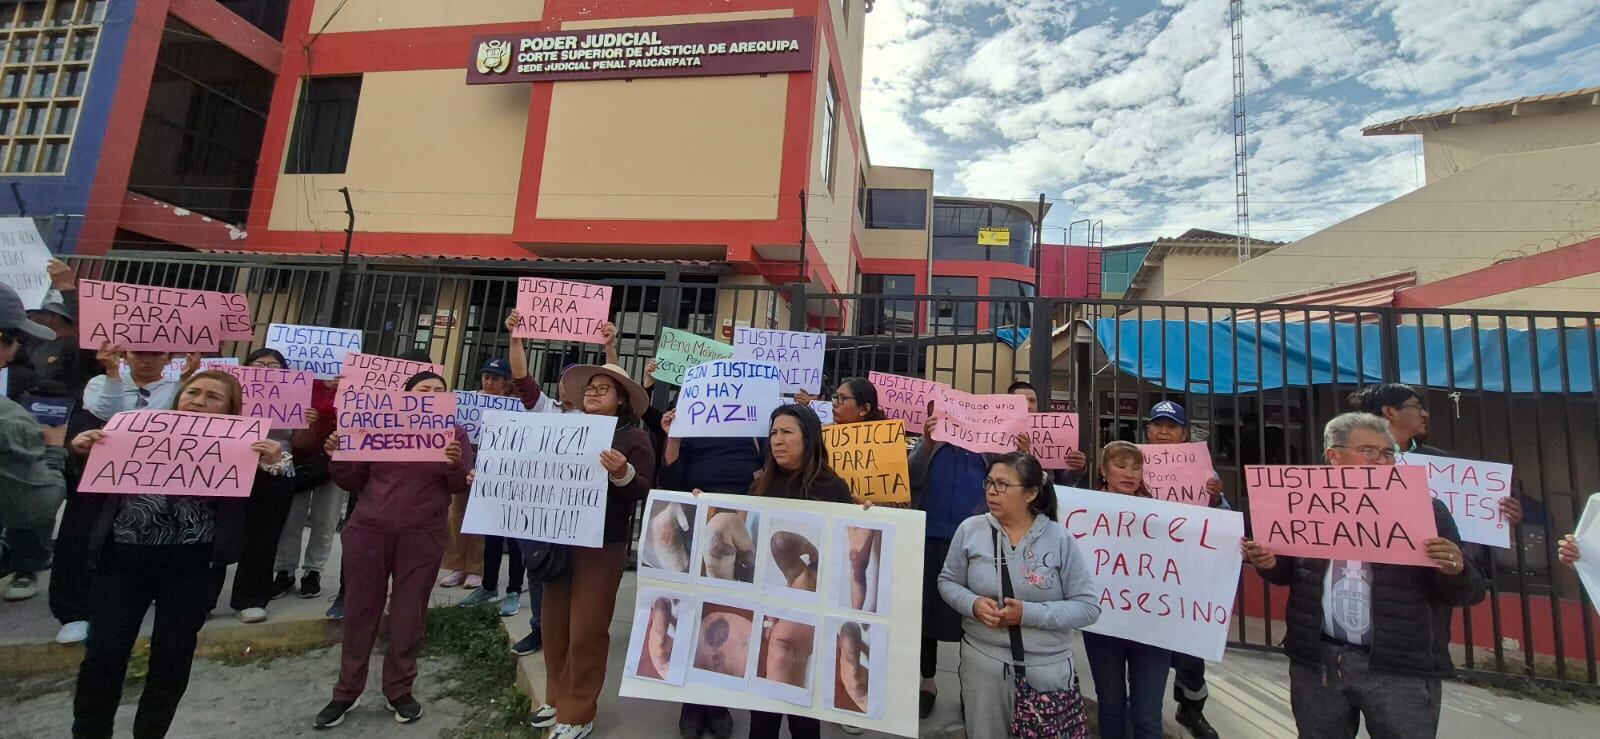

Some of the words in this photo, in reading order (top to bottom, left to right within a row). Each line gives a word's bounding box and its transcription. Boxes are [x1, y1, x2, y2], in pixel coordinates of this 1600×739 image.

[517, 51, 558, 63] CORTE
[560, 47, 624, 61] SUPERIOR
[626, 46, 643, 58] DE
[645, 43, 706, 57] JUSTICIA
[708, 42, 726, 54] DE
[728, 39, 799, 54] AREQUIPA
[520, 36, 578, 51] PODER
[580, 31, 662, 49] JUDICIAL
[517, 63, 543, 73] SEDE
[544, 61, 591, 72] JUDICIAL
[592, 59, 627, 70] PENAL
[628, 56, 701, 69] PAUCARPATA
[83, 281, 207, 311] JUSTICIA
[520, 279, 605, 301] JUSTICIA
[113, 304, 183, 325] PARA
[532, 296, 578, 313] PARA
[90, 322, 214, 346] ARIANA
[516, 315, 604, 335] ARIANITA
[271, 325, 361, 349] JUSTICIA
[736, 328, 823, 351] JUSTICIA
[287, 345, 334, 359] PARA
[752, 348, 801, 363] PARA
[347, 354, 434, 375] JUSTICIA
[685, 365, 708, 383] SIN
[712, 361, 780, 380] JUSTICIA
[779, 368, 820, 385] NITA
[872, 373, 936, 394] JUSTICIA
[241, 383, 280, 399] ARA
[343, 390, 393, 410] PENA
[399, 396, 435, 413] DE
[683, 384, 700, 401] NO
[706, 382, 744, 399] HAY
[885, 389, 925, 406] PARA
[339, 412, 405, 428] CARCEL
[407, 414, 456, 430] PARA
[457, 408, 480, 421] NO
[688, 401, 758, 426] PAZ!!!
[1030, 415, 1074, 429] ICIA
[108, 412, 261, 441] JUSTICIA
[822, 422, 906, 448] JUSTICIA
[131, 435, 222, 463] PARA
[337, 435, 356, 451] EL
[537, 426, 590, 456] JUEZ!!
[832, 449, 879, 471] PARA
[1143, 449, 1196, 465] usticia
[90, 460, 239, 490] ARIANA
[496, 457, 541, 480] IGNORE
[543, 461, 596, 482] NUESTRO
[1148, 472, 1177, 482] Para
[1248, 466, 1408, 491] JUSTICIA
[1428, 462, 1506, 492] MAS
[850, 473, 908, 496] NITA
[1151, 485, 1207, 502] IANA
[560, 486, 602, 508] MERECE
[1288, 492, 1380, 515] PARA
[499, 503, 580, 540] JUSTICIA!!
[1268, 520, 1416, 551] ARIANA
[1094, 549, 1181, 585] PARA
